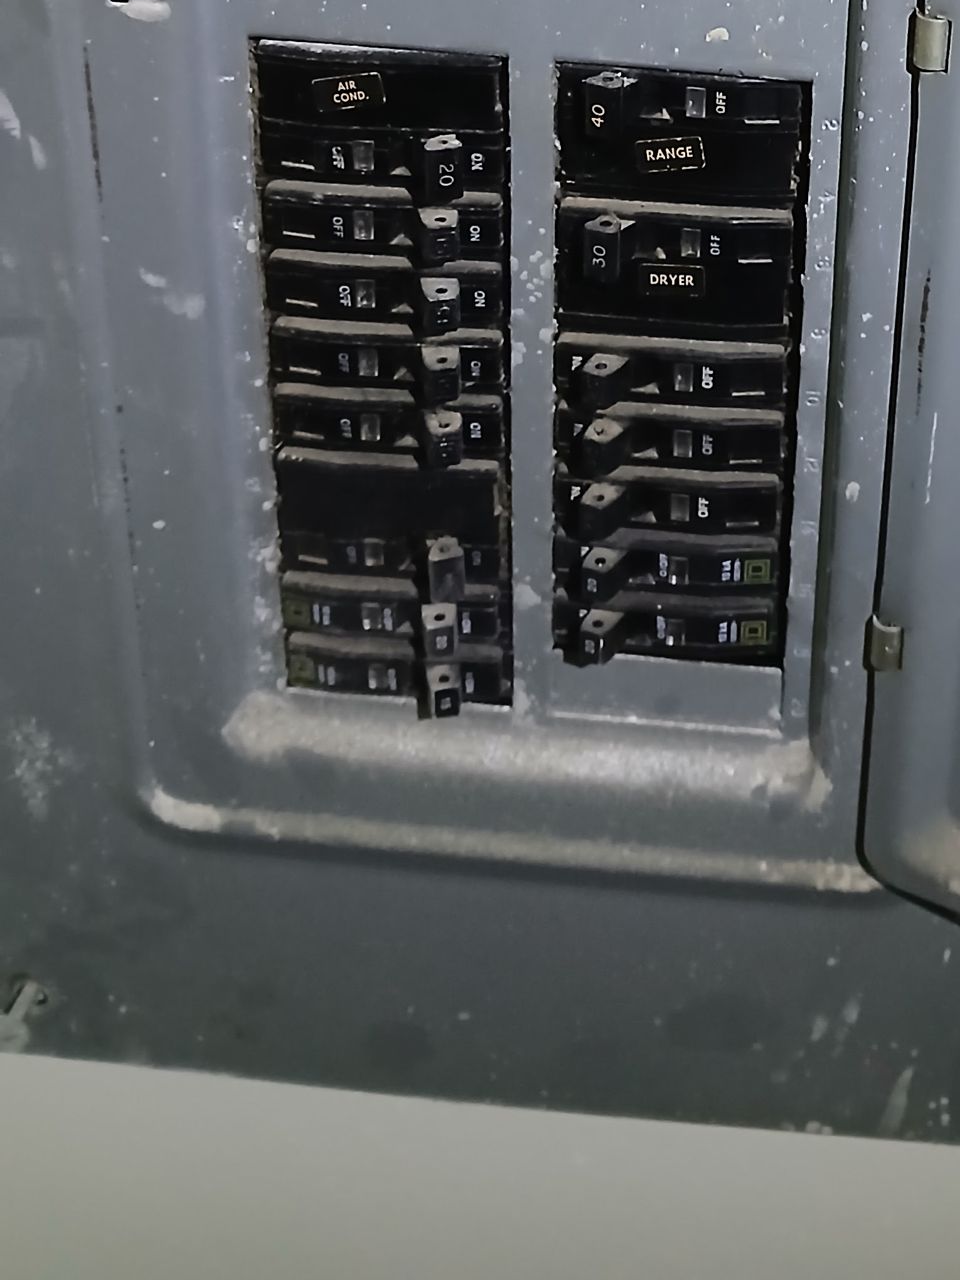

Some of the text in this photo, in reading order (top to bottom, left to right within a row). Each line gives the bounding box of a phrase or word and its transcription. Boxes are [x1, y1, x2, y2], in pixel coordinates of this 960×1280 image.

[332, 90, 370, 104] COND.
[336, 80, 356, 92] AIR
[716, 91, 726, 114] OFF
[592, 104, 606, 128] 40
[471, 153, 484, 170] ON
[646, 146, 694, 162] RANGE
[439, 164, 454, 186] 20
[332, 216, 344, 238] OFF
[470, 225, 481, 242] ON
[710, 234, 721, 256] OFF
[592, 245, 606, 268] 30
[650, 273, 694, 287] DRYER
[338, 285, 351, 308] OFF
[474, 290, 486, 308] ON
[701, 366, 714, 389] OFF
[702, 434, 713, 456] OFF
[698, 496, 710, 518] OFF
